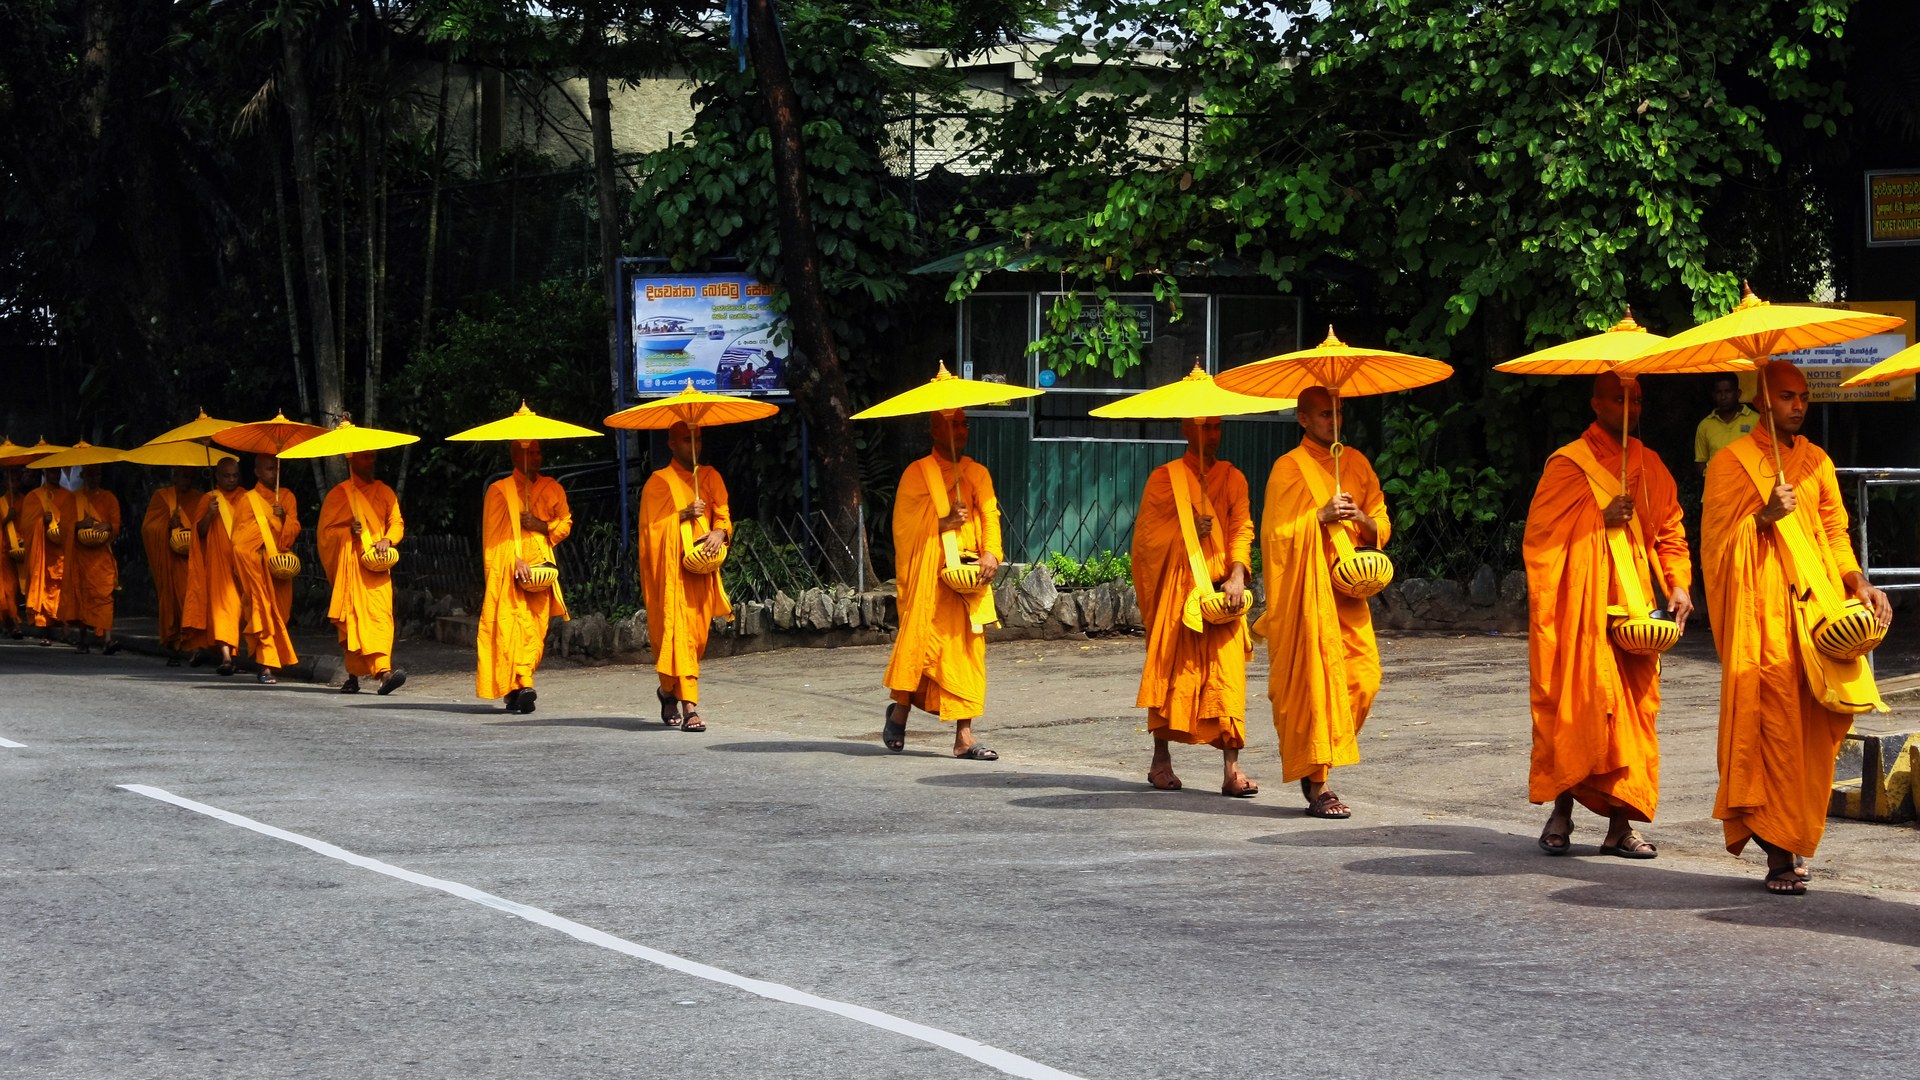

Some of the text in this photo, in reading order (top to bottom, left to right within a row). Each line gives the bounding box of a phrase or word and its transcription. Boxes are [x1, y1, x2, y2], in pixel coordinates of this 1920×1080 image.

[1876, 218, 1920, 230] TICKET COUNTE
[646, 284, 696, 301] දියවන්නා
[745, 283, 780, 298] සේවා
[1807, 370, 1841, 379] NOTICE
[1812, 391, 1841, 399] totally
[1844, 390, 1890, 399] prohibited
